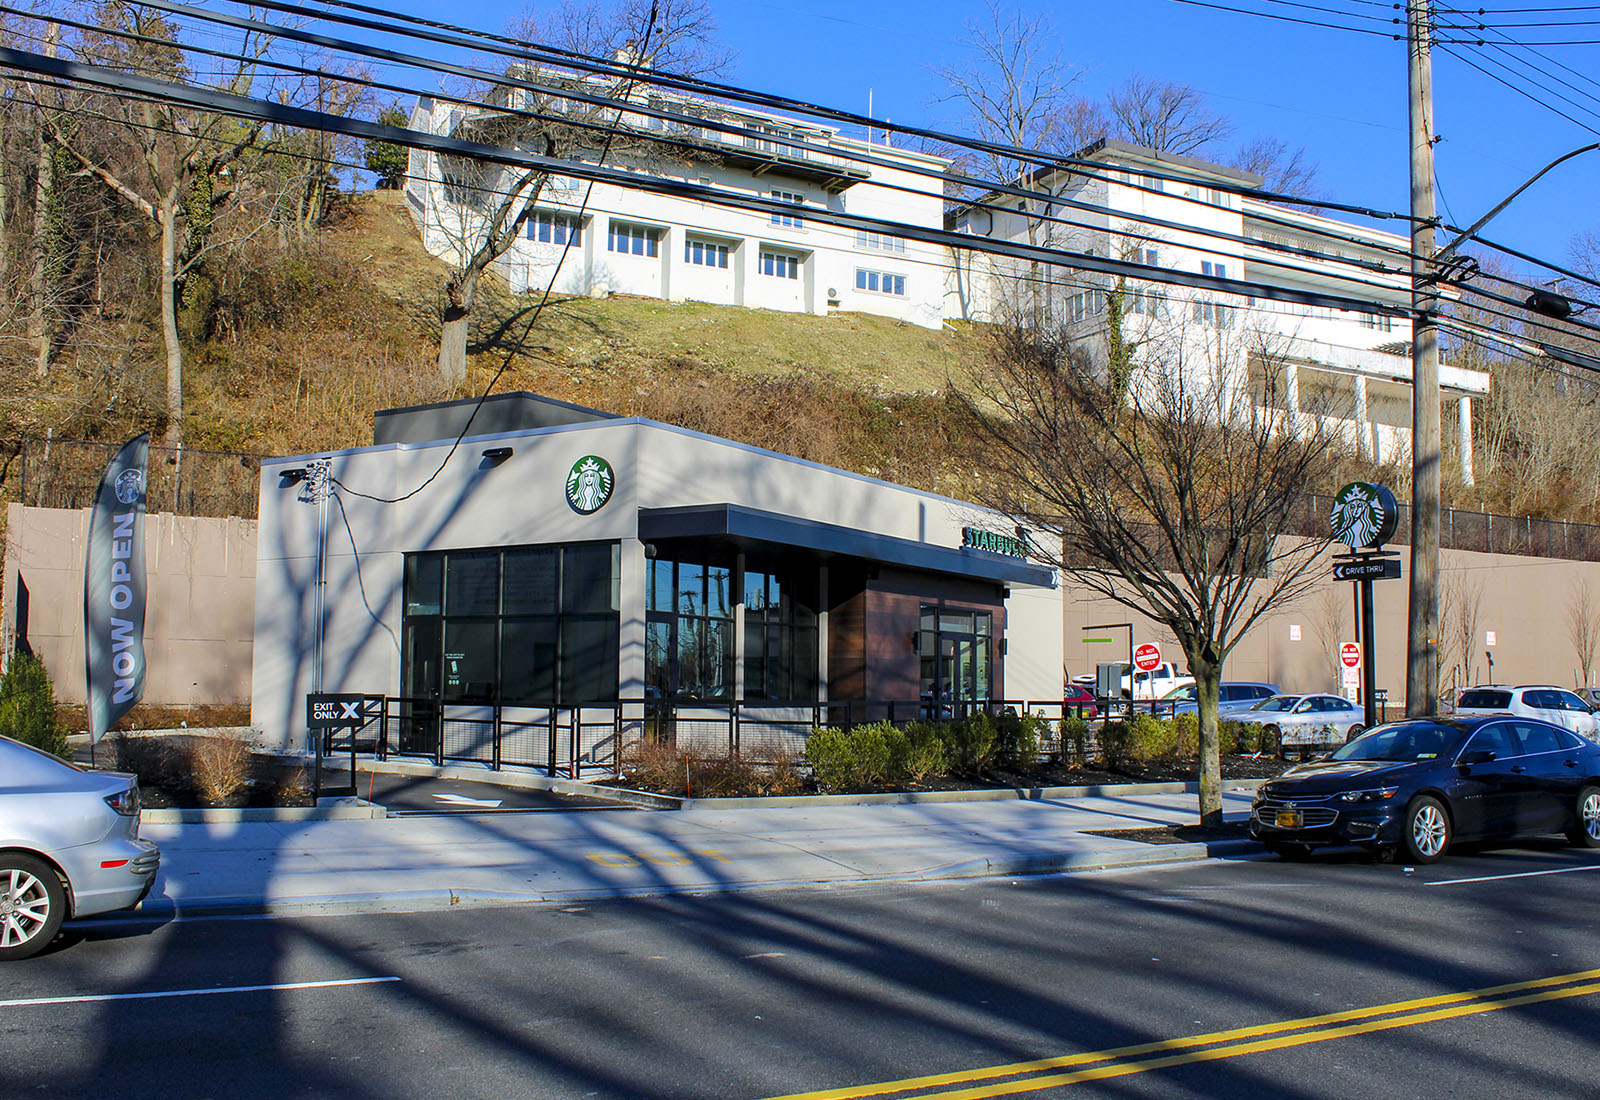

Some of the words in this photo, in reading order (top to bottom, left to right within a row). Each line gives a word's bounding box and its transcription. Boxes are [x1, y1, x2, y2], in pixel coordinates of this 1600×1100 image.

[963, 526, 1032, 556] STARBUC
[110, 512, 135, 610] OPEN
[1345, 566, 1364, 575] DRIVE
[1366, 565, 1384, 573] THRU
[111, 617, 137, 704] NOW
[313, 711, 339, 720] ONLY
[314, 702, 335, 711] EXIT
